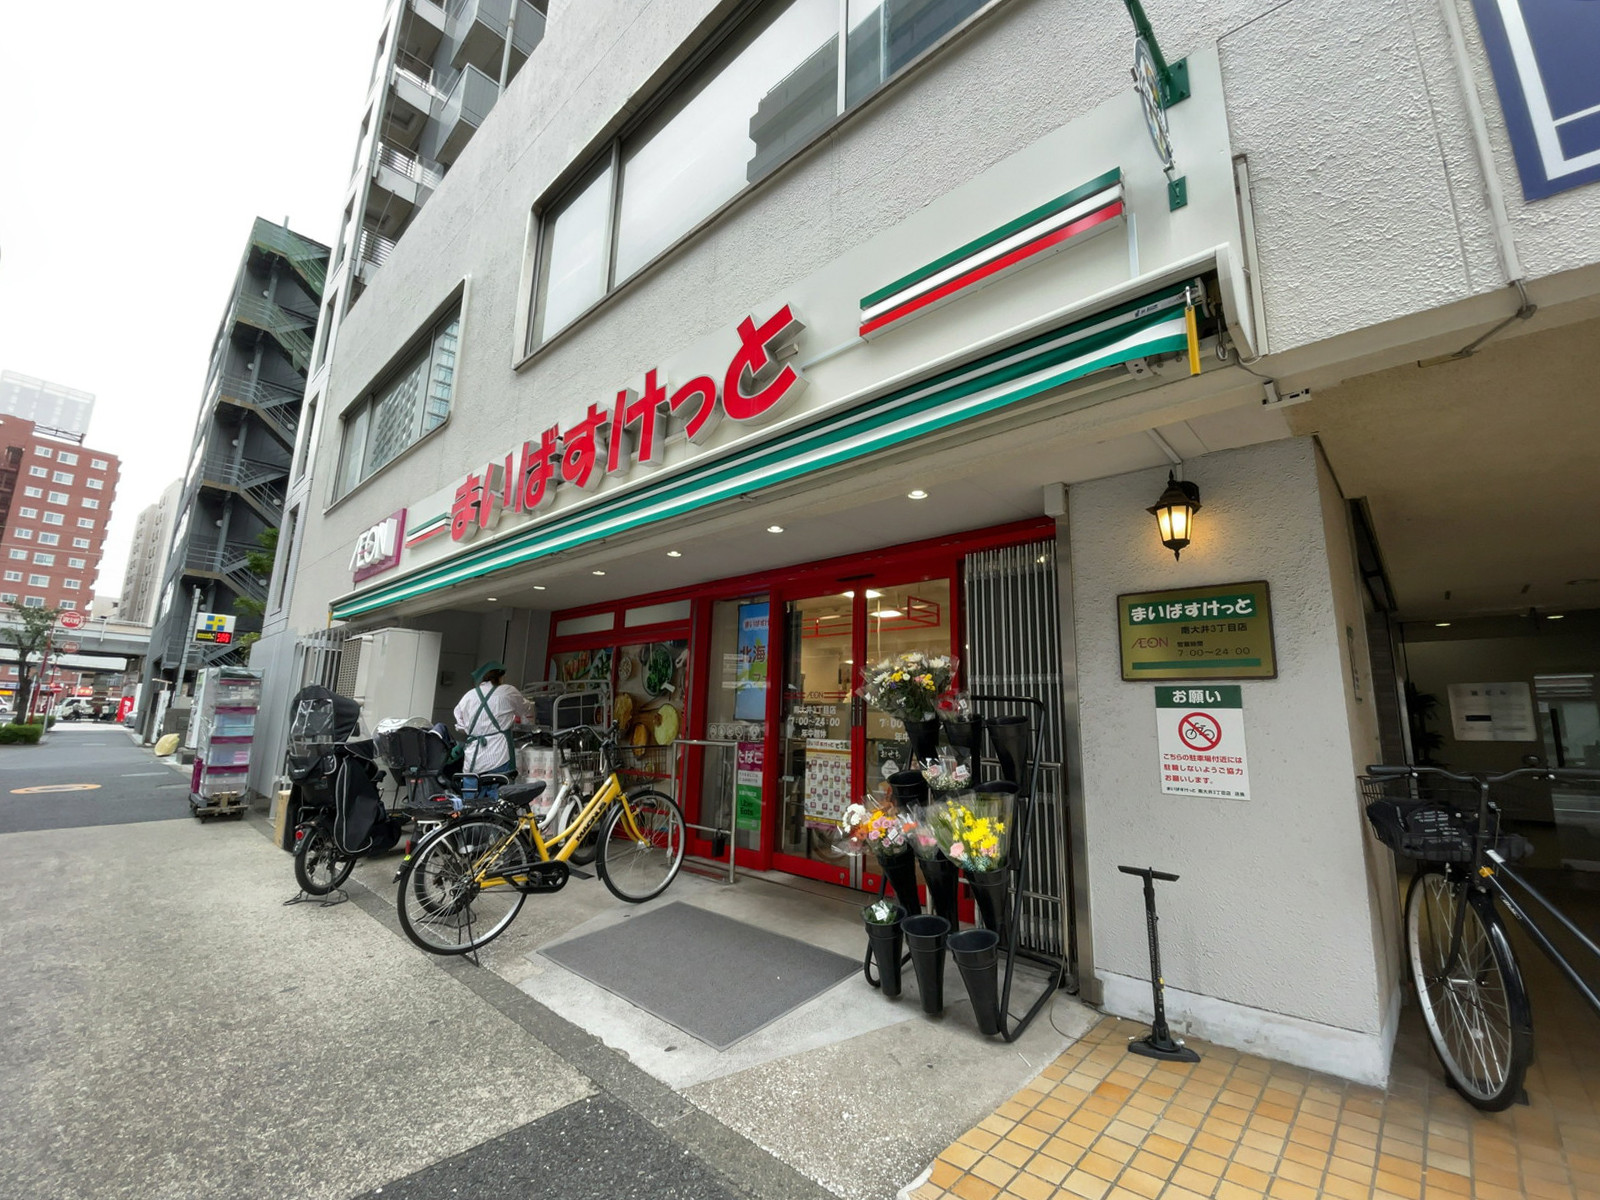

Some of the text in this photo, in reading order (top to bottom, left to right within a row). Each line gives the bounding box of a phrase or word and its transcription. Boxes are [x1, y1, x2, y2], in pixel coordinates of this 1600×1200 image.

[450, 303, 803, 542] まいばすけっと
[1130, 598, 1253, 622] まいばすけっと
[1181, 623, 1248, 634] 南大井3丁目店
[1172, 689, 1221, 704] お願い
[1163, 753, 1243, 764] こちらの駐車場付近には
[1163, 764, 1244, 776] 駐輪しないようご協力
[1165, 775, 1214, 784] お願いします。
